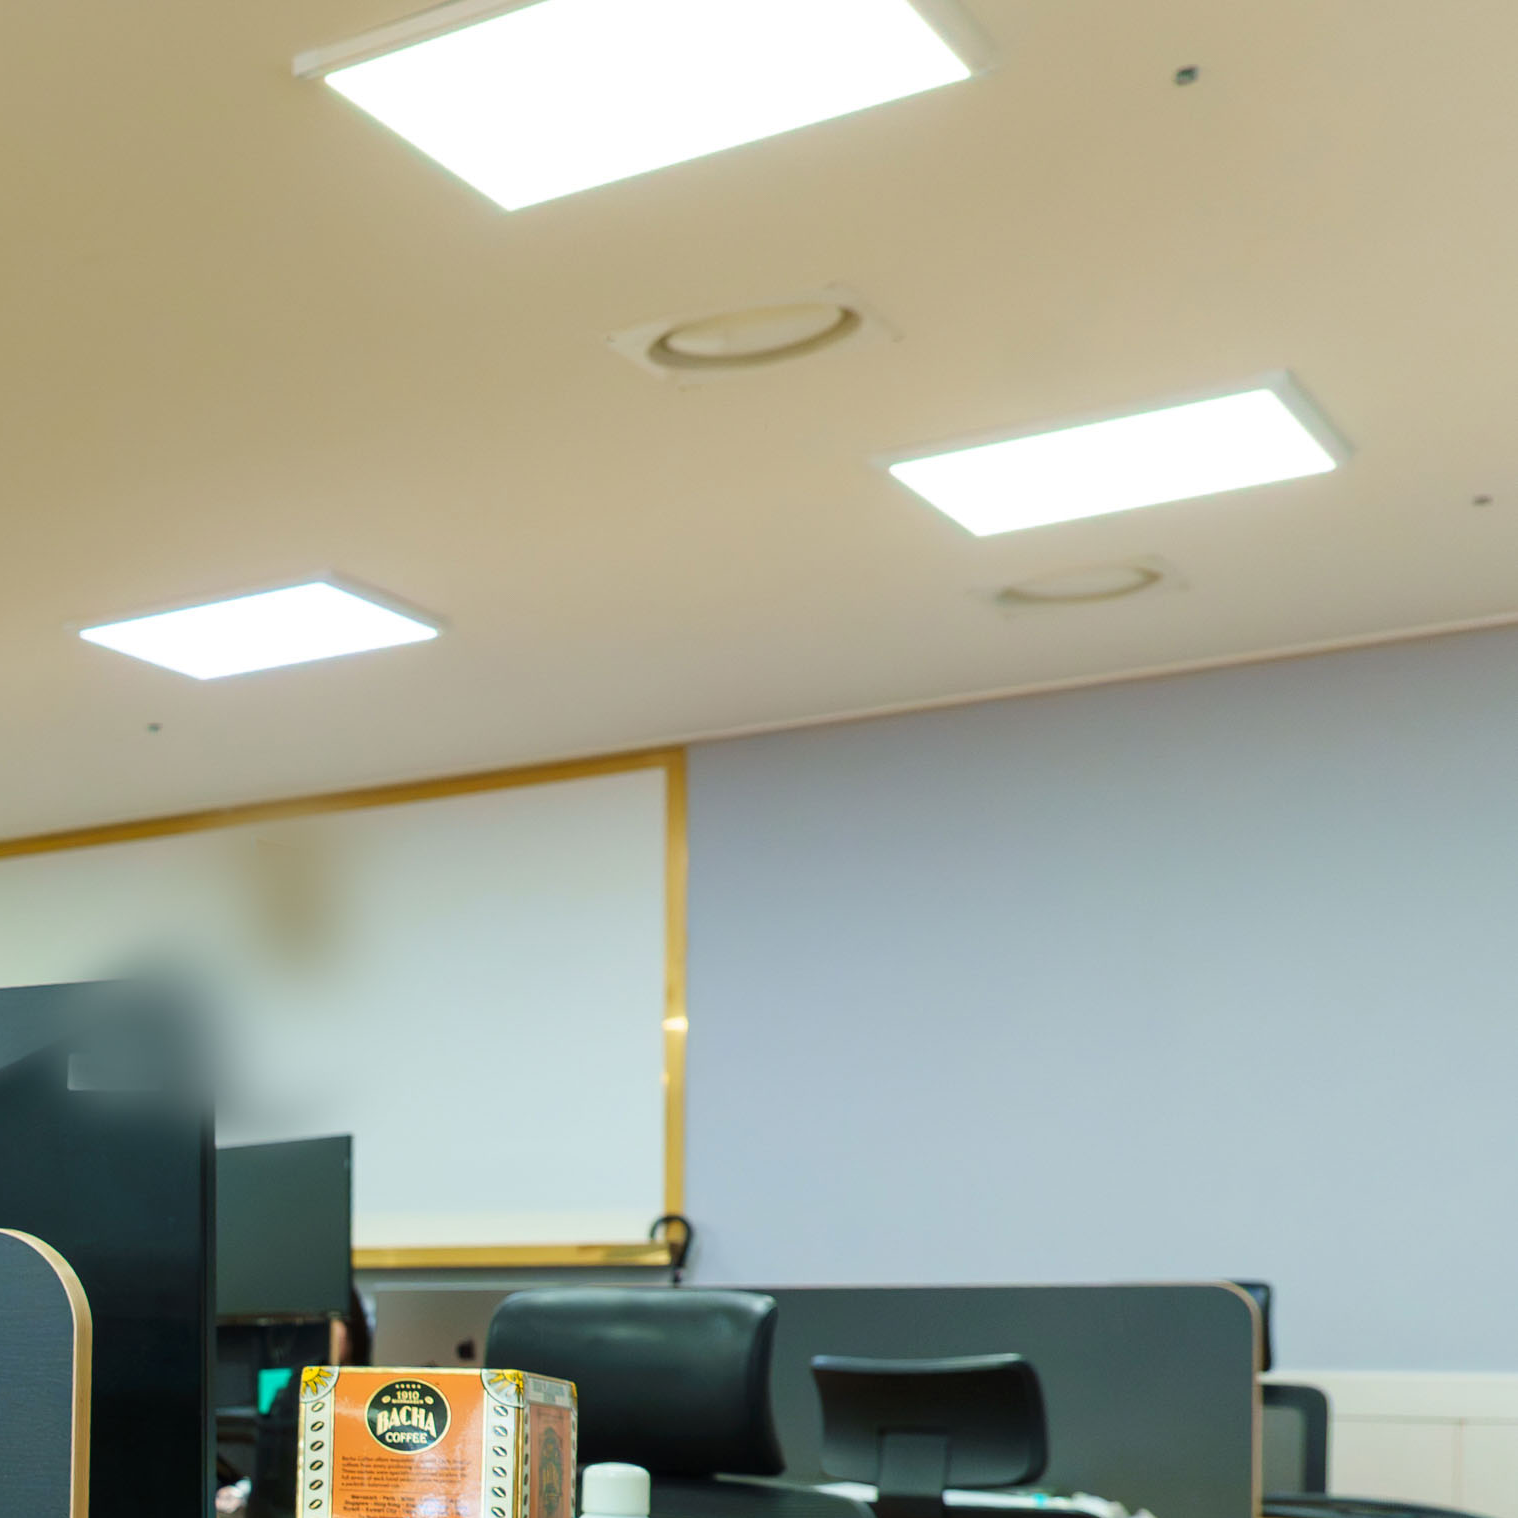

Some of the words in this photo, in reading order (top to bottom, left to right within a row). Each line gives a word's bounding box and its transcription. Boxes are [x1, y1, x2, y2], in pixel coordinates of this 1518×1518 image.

[396, 1390, 420, 1400] 1910
[376, 1405, 437, 1439] BACHA
[385, 1431, 428, 1444] COFFEE
